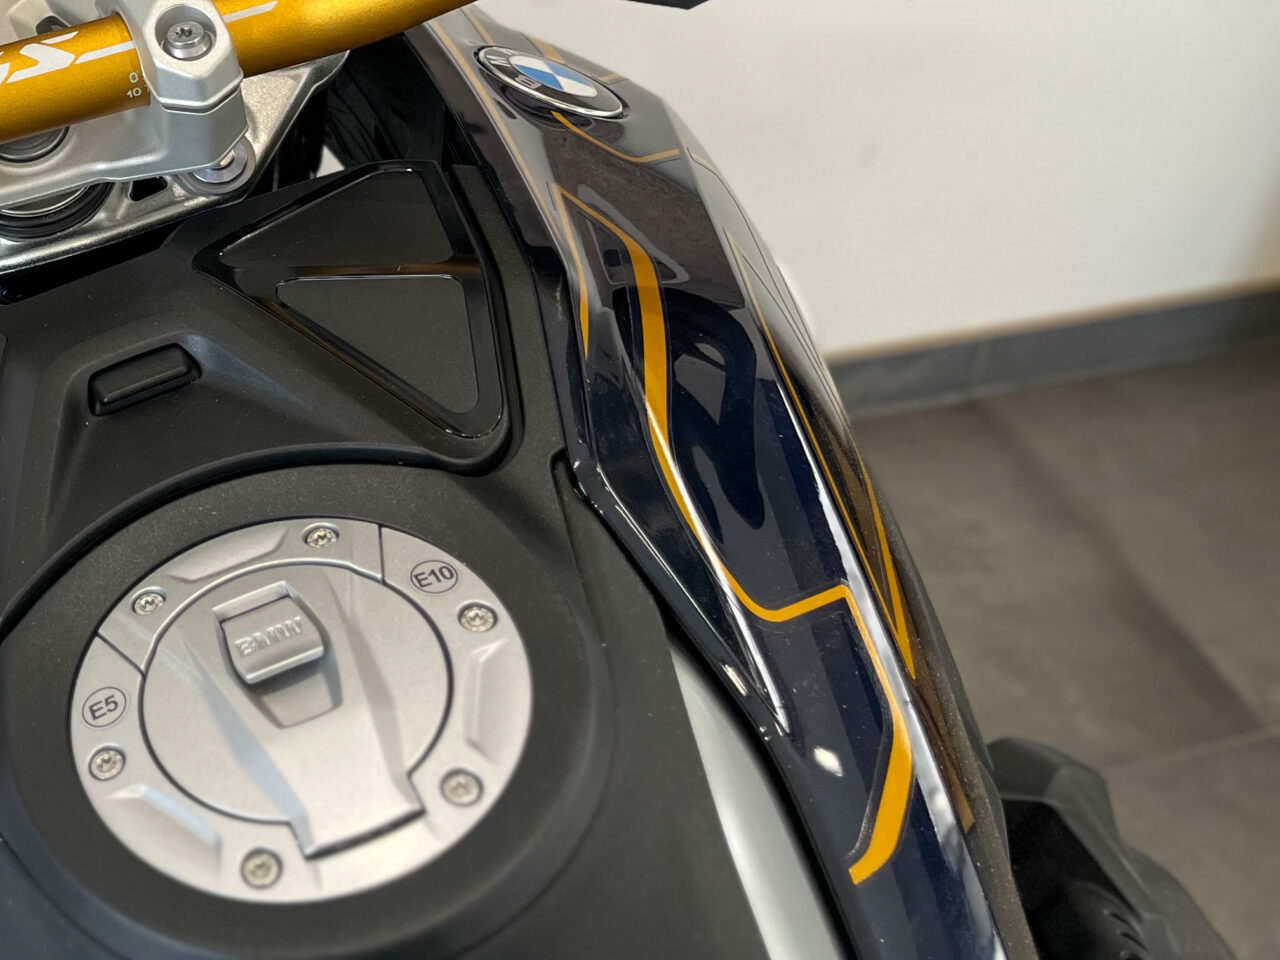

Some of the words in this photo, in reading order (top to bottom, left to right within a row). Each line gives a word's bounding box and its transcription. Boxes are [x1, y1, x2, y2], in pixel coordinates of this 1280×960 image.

[129, 72, 139, 83] 0
[126, 87, 141, 98] 10
[412, 564, 455, 589] E10
[233, 615, 305, 657] BMW
[88, 695, 119, 721] E5
